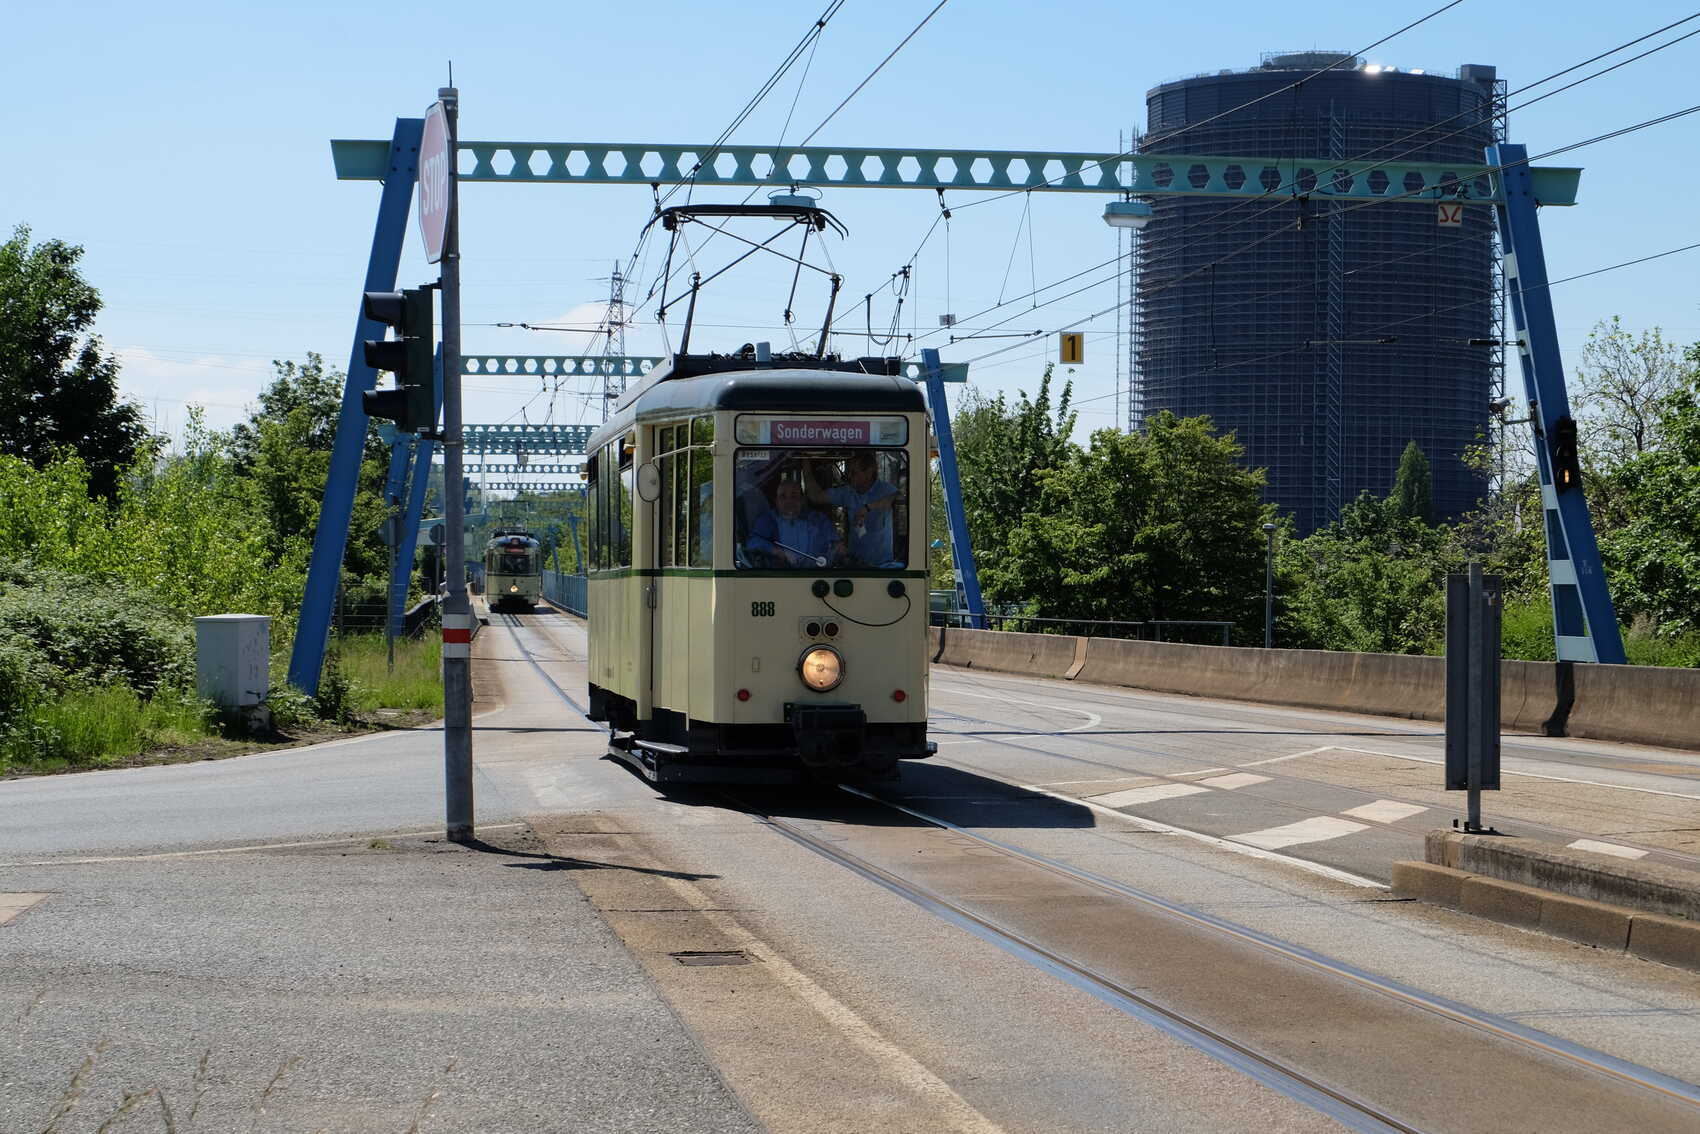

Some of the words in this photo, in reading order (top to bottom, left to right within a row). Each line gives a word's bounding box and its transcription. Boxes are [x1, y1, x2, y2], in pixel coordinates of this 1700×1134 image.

[423, 152, 445, 216] STOP
[1067, 335, 1075, 360] 1
[776, 423, 863, 442] Sonderwagen
[751, 601, 775, 617] 888
